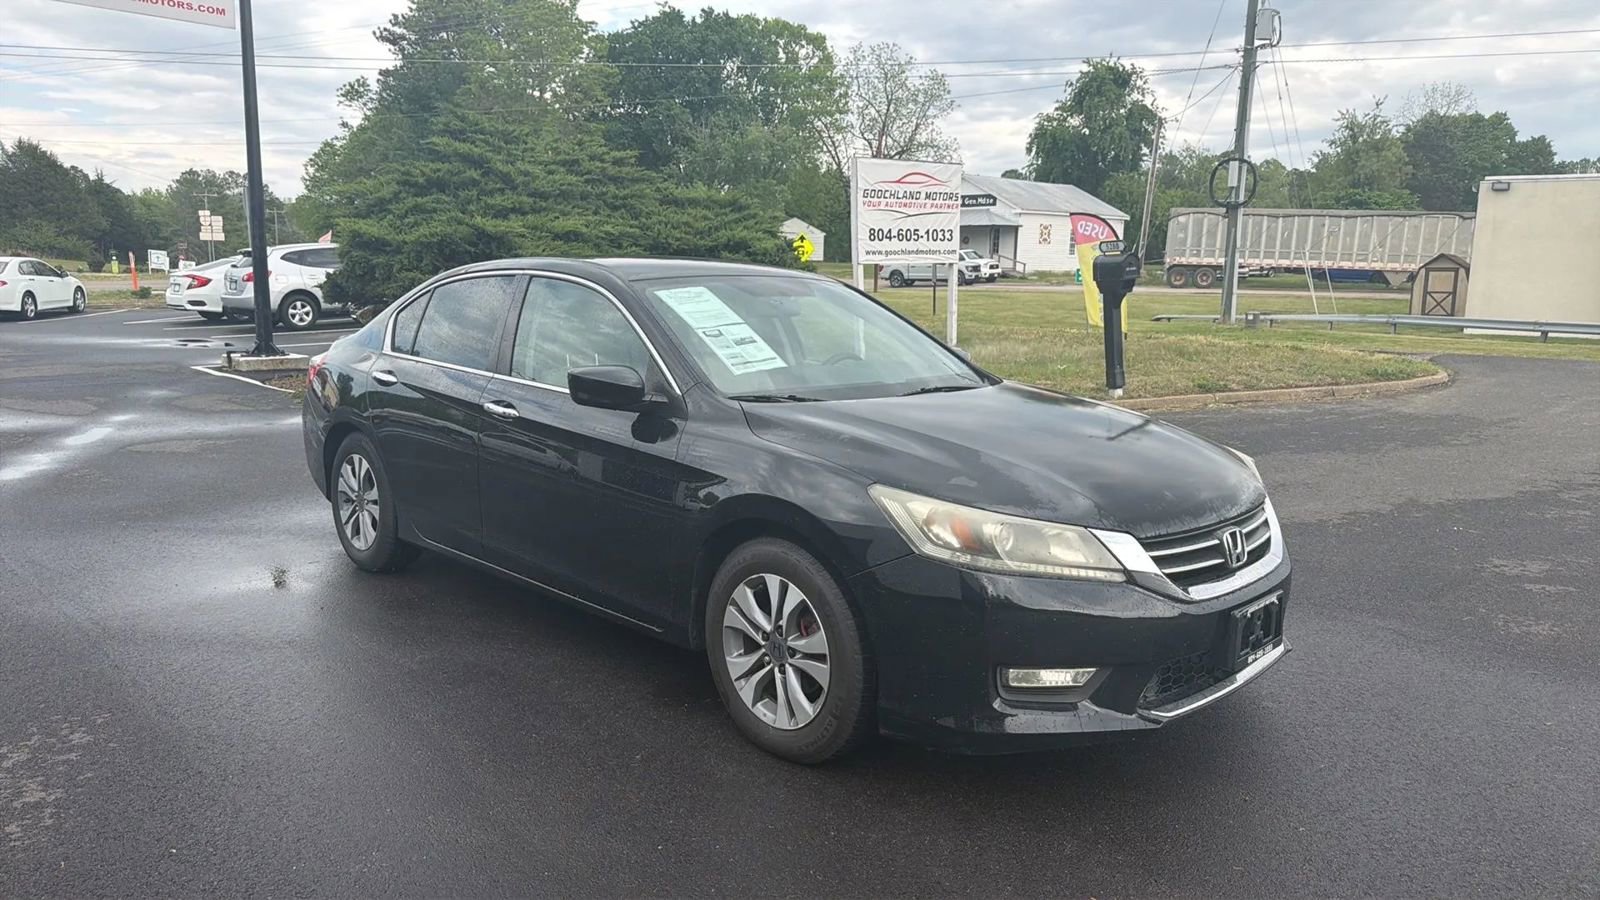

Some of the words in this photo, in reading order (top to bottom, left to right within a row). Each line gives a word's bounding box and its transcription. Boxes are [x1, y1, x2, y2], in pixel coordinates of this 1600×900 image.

[133, 0, 226, 16] MOTORS.COM
[862, 188, 921, 200] GOOCHLAND
[924, 191, 959, 201] MOTORS
[862, 200, 881, 208] YOUR
[884, 201, 927, 209] AUTOMOTIVE
[930, 202, 959, 210] PARTNER
[868, 227, 954, 242] 804-605-1033
[865, 248, 957, 257] www.goochlandmotors.com
